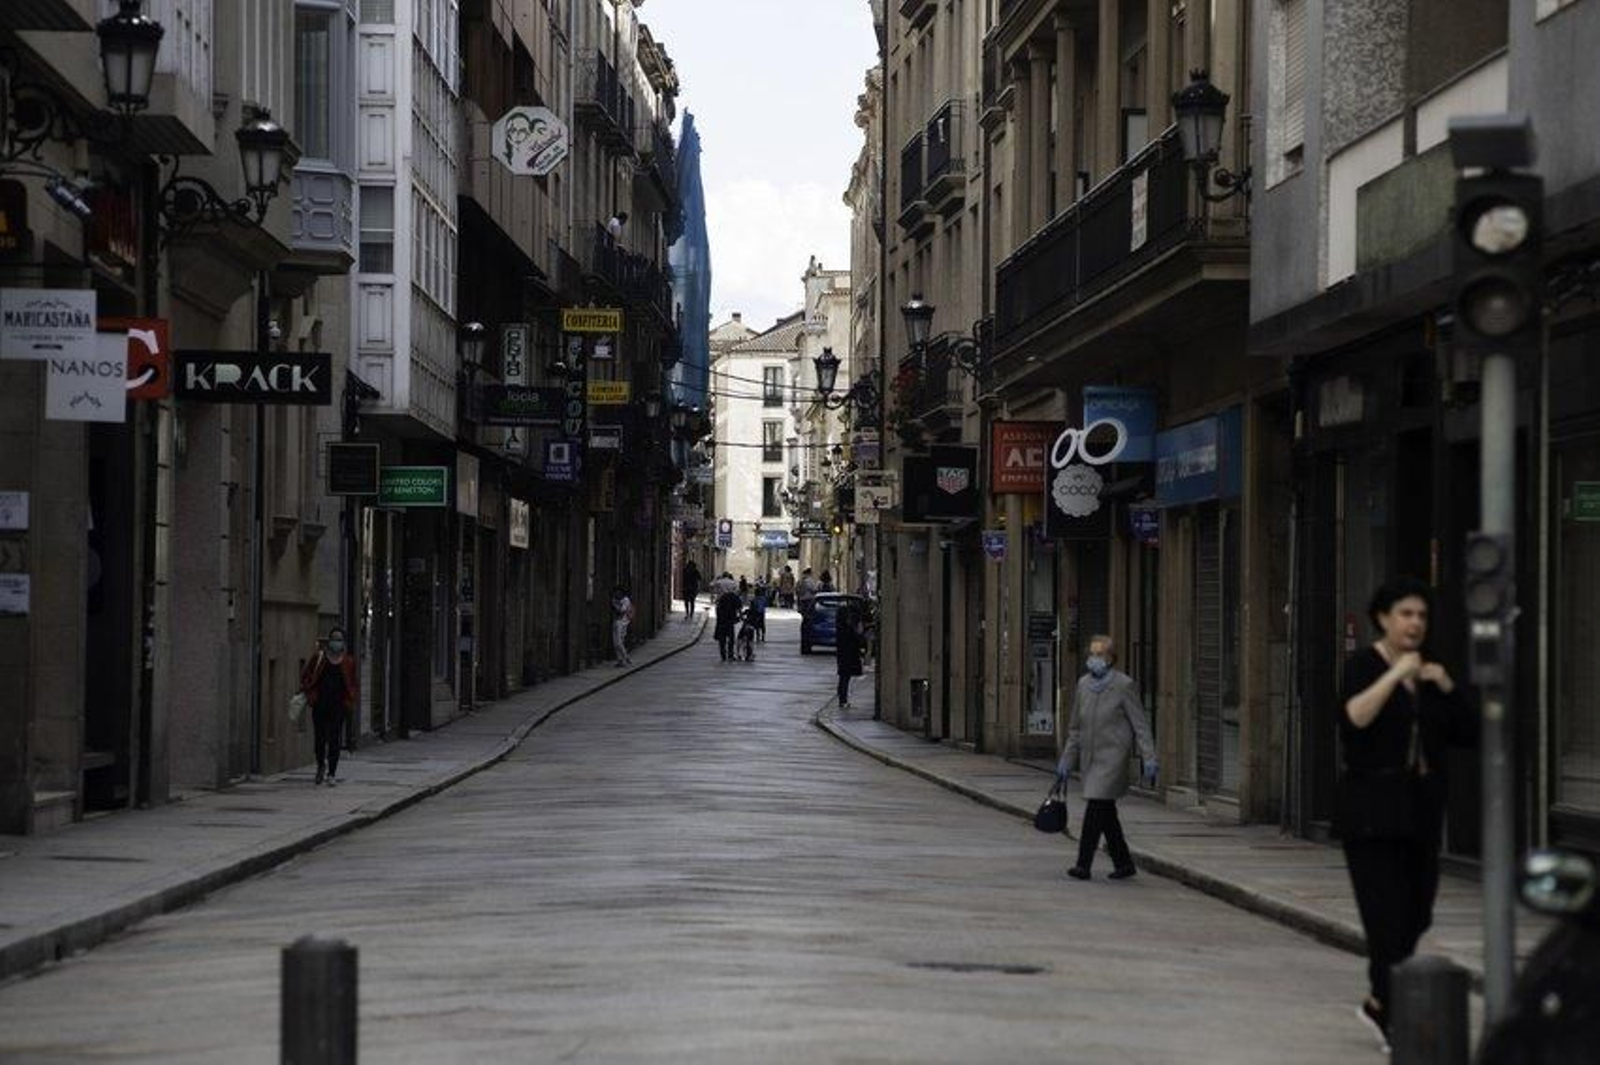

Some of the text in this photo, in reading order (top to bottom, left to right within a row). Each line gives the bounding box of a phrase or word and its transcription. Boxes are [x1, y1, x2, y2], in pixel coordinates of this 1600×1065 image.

[5, 309, 91, 328] MARICASTAÑA
[51, 360, 124, 378] NANOS
[185, 362, 319, 391] KRACK
[937, 467, 969, 479] TAG
[1001, 474, 1044, 482] EMPRES
